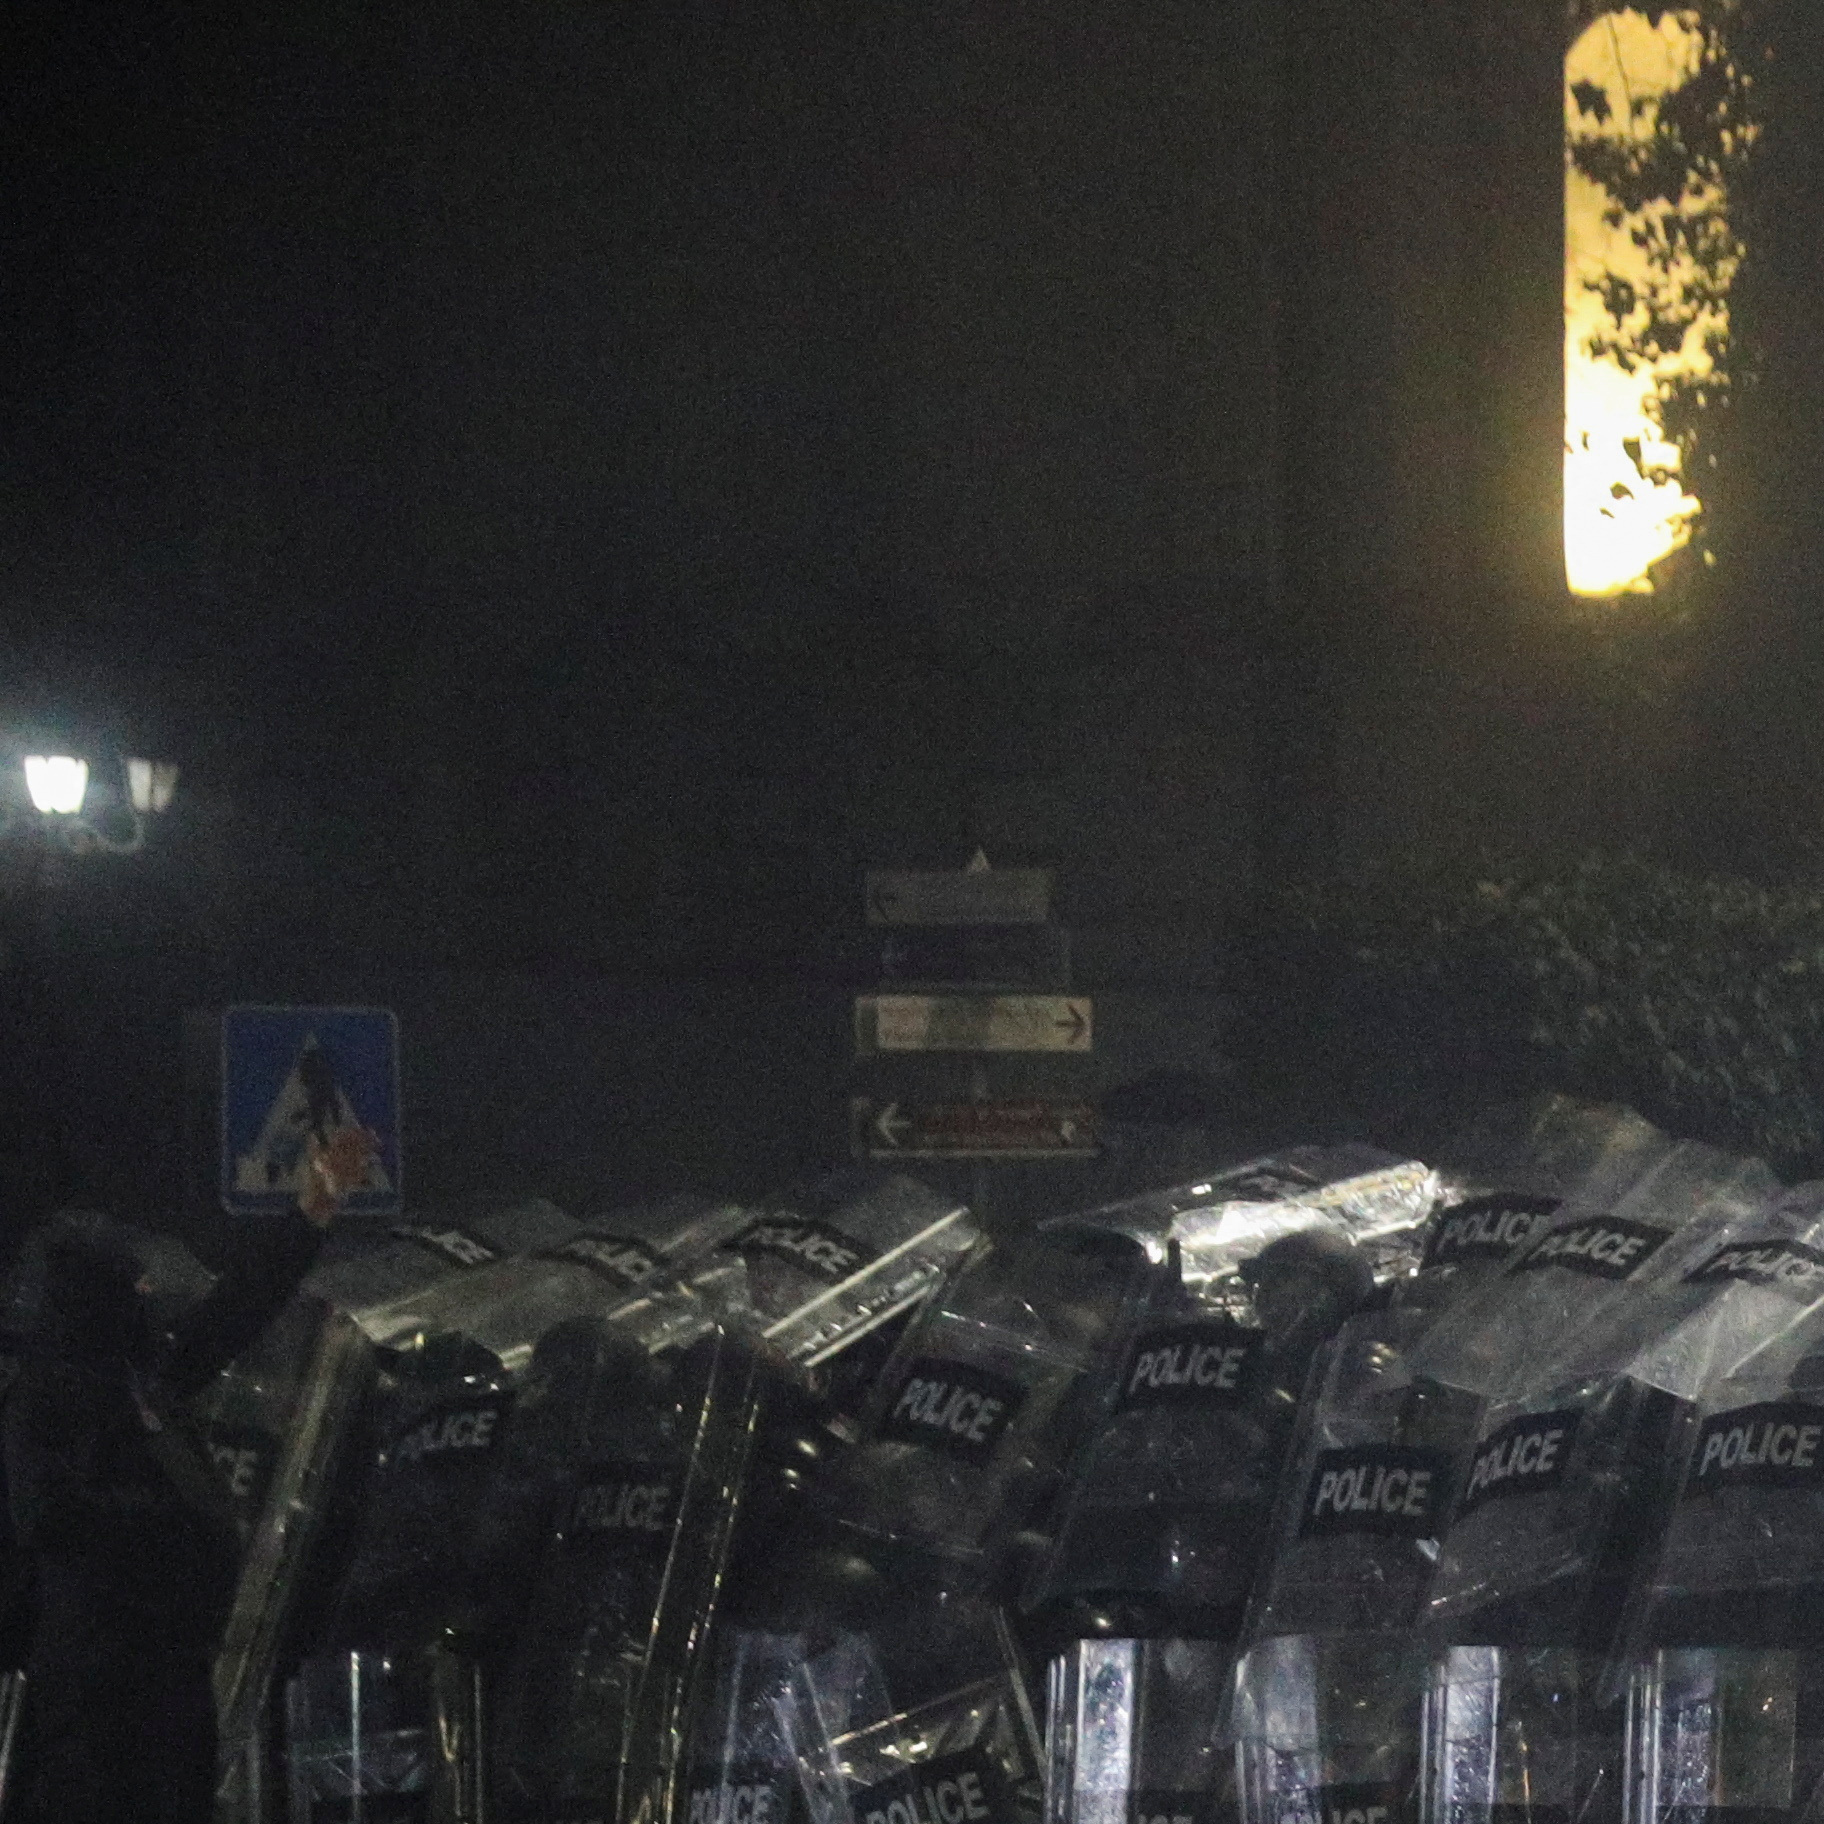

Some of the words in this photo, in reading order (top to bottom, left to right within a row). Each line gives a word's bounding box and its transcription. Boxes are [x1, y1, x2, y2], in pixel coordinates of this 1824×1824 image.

[1533, 1226, 1643, 1267] POLICE
[1129, 1346, 1245, 1394] POLICE
[893, 1377, 1003, 1443] POLICE
[1468, 1429, 1563, 1500] POLICE
[1698, 1422, 1822, 1477] POLICE
[1314, 1468, 1432, 1516] POLICE
